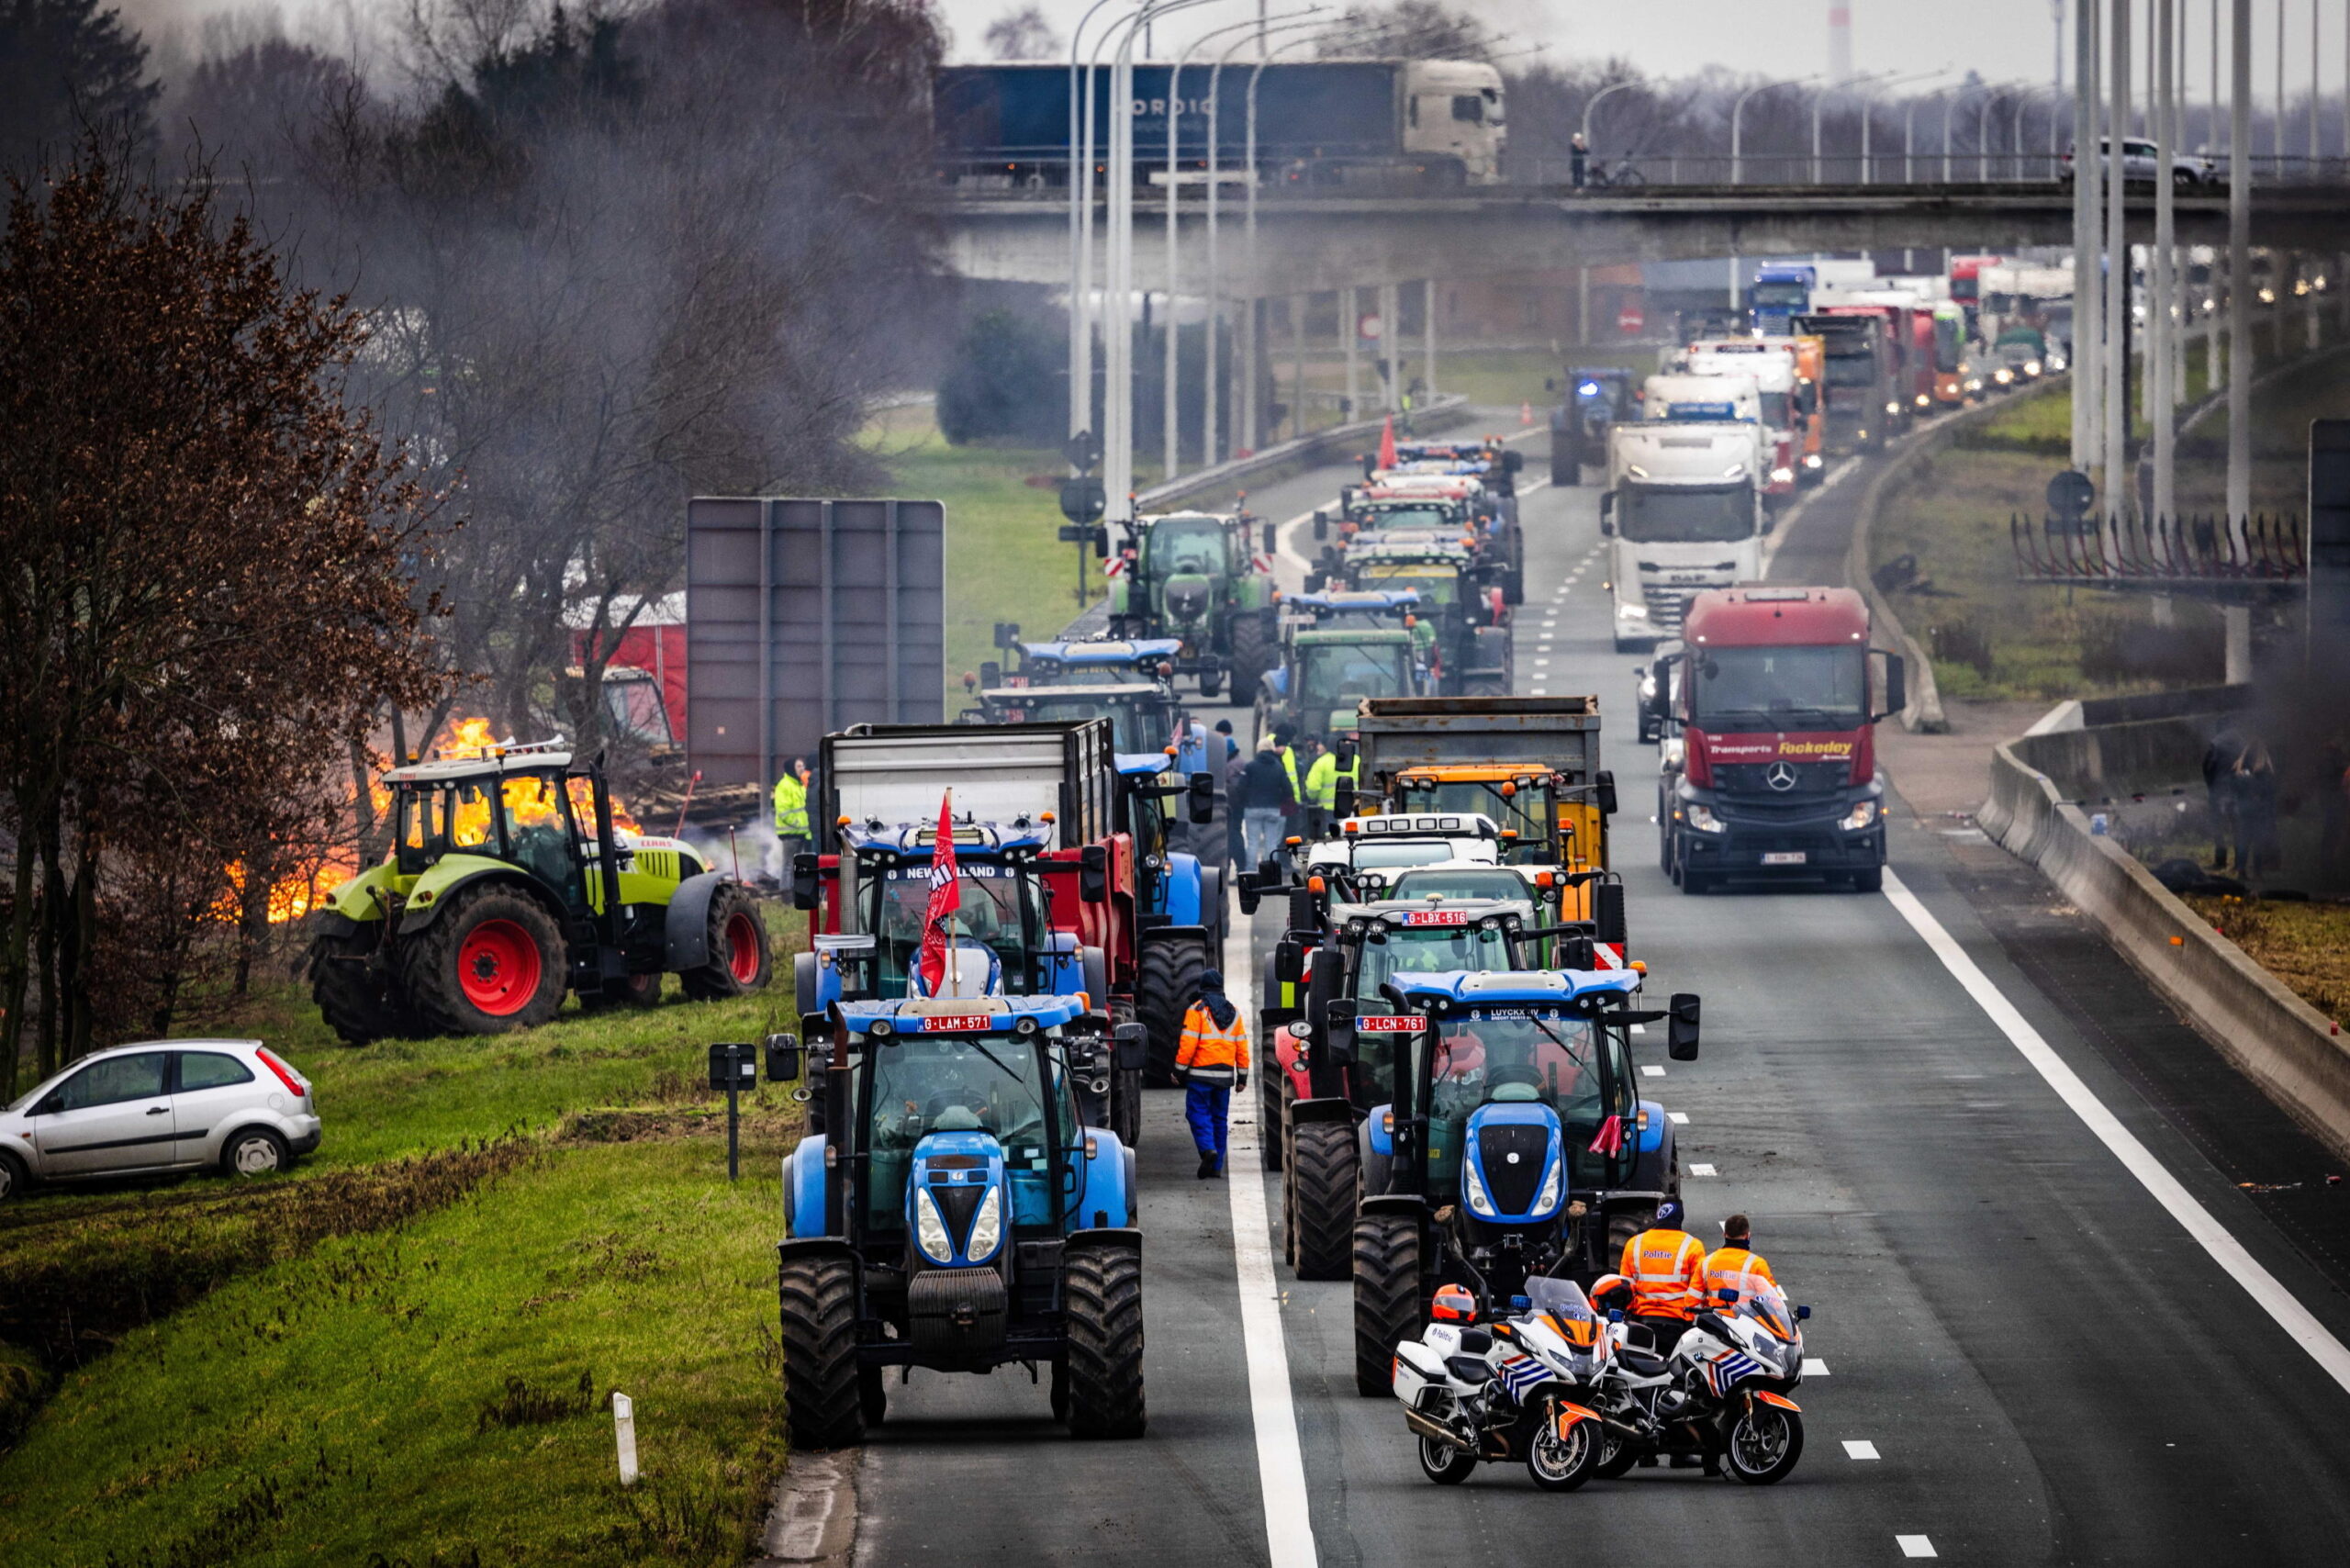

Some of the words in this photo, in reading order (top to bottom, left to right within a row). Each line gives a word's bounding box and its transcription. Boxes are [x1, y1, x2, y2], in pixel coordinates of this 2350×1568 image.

[1710, 745, 1772, 755] Transports
[1643, 1250, 1673, 1260] Politie
[1709, 1270, 1737, 1280] Politie
[1437, 1329, 1454, 1343] Politie
